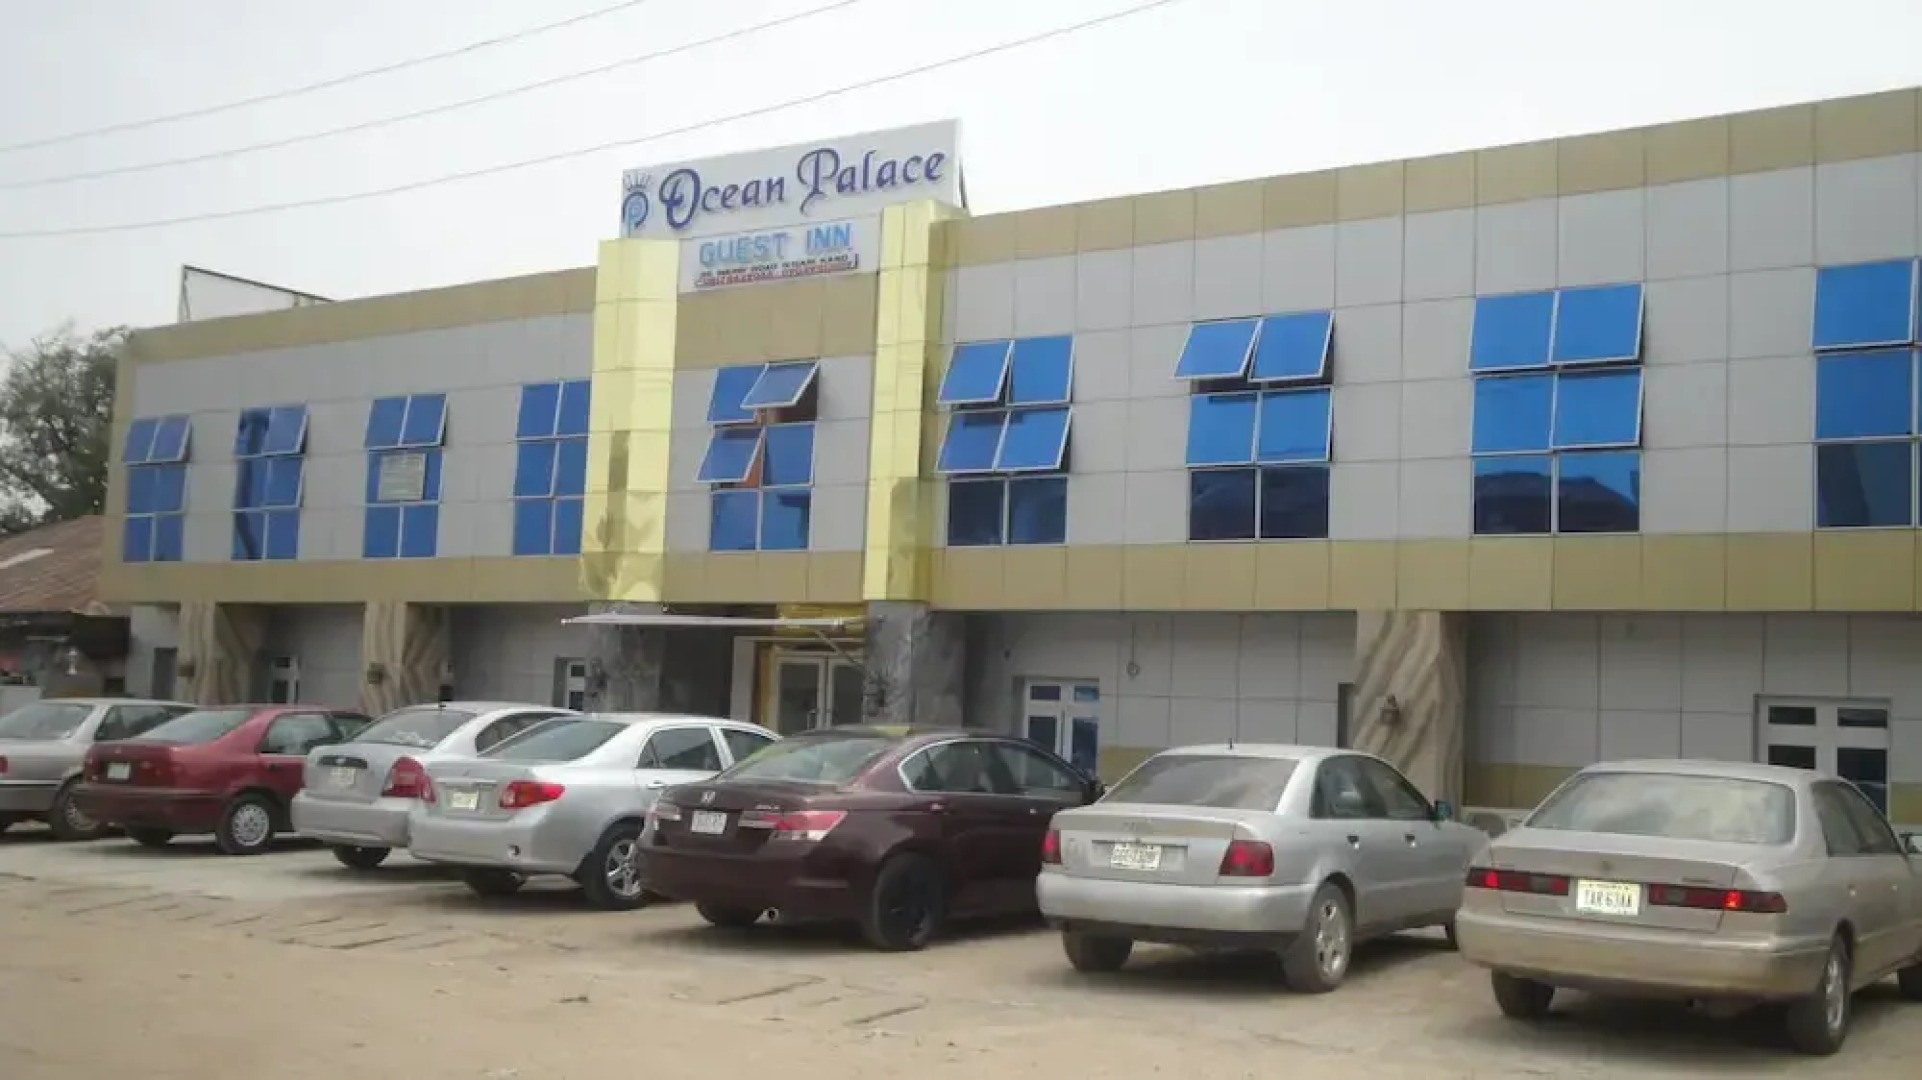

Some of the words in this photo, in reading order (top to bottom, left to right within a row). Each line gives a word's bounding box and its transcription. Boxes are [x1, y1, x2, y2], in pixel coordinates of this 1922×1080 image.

[659, 168, 785, 230] Ocean
[797, 147, 946, 216] Palace
[700, 232, 788, 268] GUEST
[806, 223, 852, 254] INN
